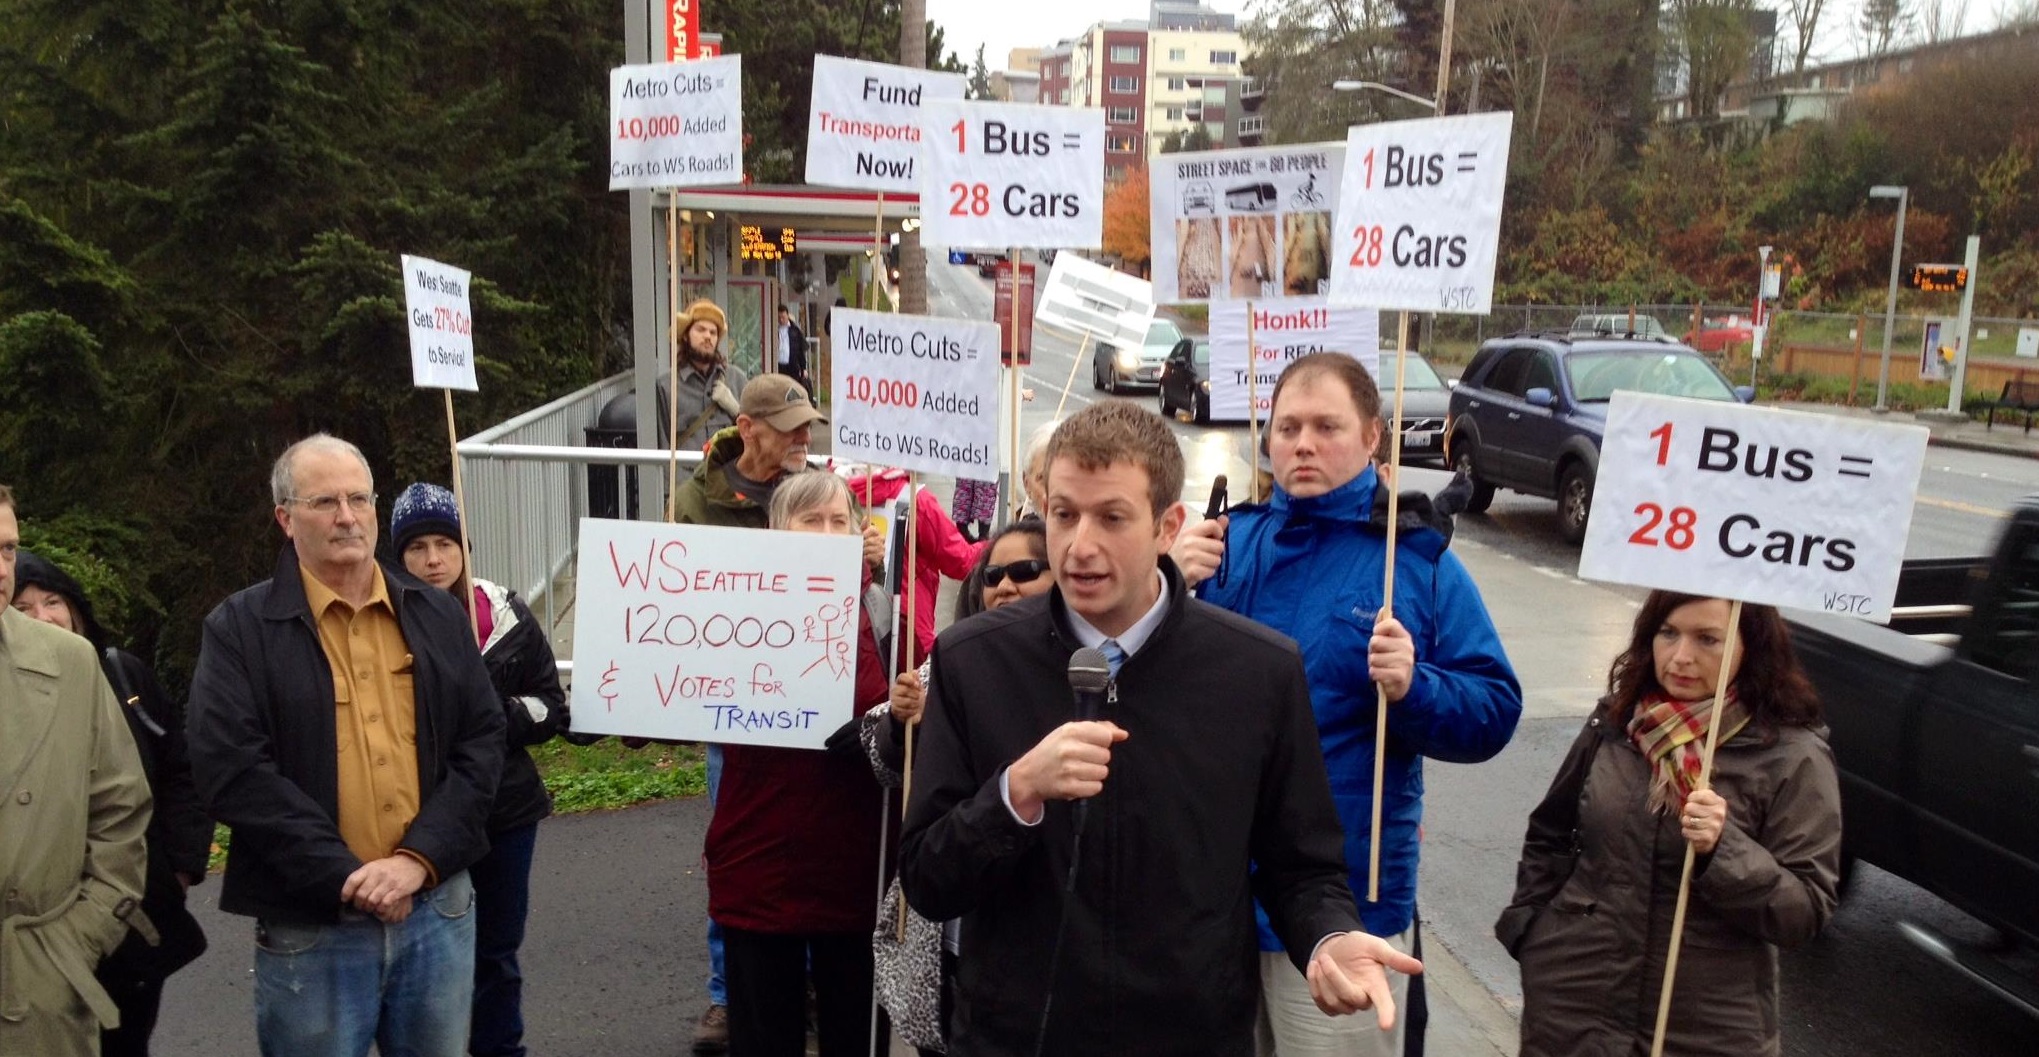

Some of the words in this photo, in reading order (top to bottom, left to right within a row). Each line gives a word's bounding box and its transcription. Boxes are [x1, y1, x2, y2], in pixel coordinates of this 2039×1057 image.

[674, 72, 712, 96] Cuts
[862, 76, 922, 107] Fund
[618, 115, 680, 142] 10,000
[684, 115, 727, 136] Added
[951, 118, 966, 154] 1
[983, 120, 1051, 157] Bus
[1063, 133, 1081, 149] =
[611, 160, 643, 178] Cars
[647, 159, 660, 175] to
[664, 158, 685, 175] WS
[689, 153, 734, 173] Roads!
[856, 151, 914, 180] Now!
[1178, 159, 1215, 180] STREET
[1218, 158, 1252, 176] SPACE
[1363, 147, 1374, 190] 1
[1384, 145, 1444, 188] Bus
[1457, 152, 1478, 172] =
[949, 182, 990, 217] 28
[1002, 183, 1081, 218] Cars
[1349, 224, 1383, 267] 28
[1392, 224, 1468, 268] Cars
[1440, 286, 1476, 310] WSTC
[413, 307, 434, 329] Gets
[434, 306, 456, 333] 27%
[1253, 308, 1328, 331] Honk!!
[428, 346, 437, 364] to
[847, 324, 903, 356] Metro
[911, 331, 961, 362] Cuts
[967, 348, 978, 359] =
[1254, 345, 1279, 361] For
[846, 374, 918, 408] 10,000
[922, 390, 979, 417] Added
[839, 424, 870, 448] Cars
[876, 431, 892, 451] to
[896, 433, 923, 456] WS
[929, 438, 989, 466] Roads!
[1650, 421, 1674, 467] 1
[1697, 426, 1815, 482] Bus
[1838, 455, 1873, 478] =
[1628, 502, 1697, 551] 28
[1718, 513, 1857, 572] Cars
[806, 576, 835, 592] =
[1824, 592, 1873, 616] WSTC
[625, 603, 795, 650] 120,000
